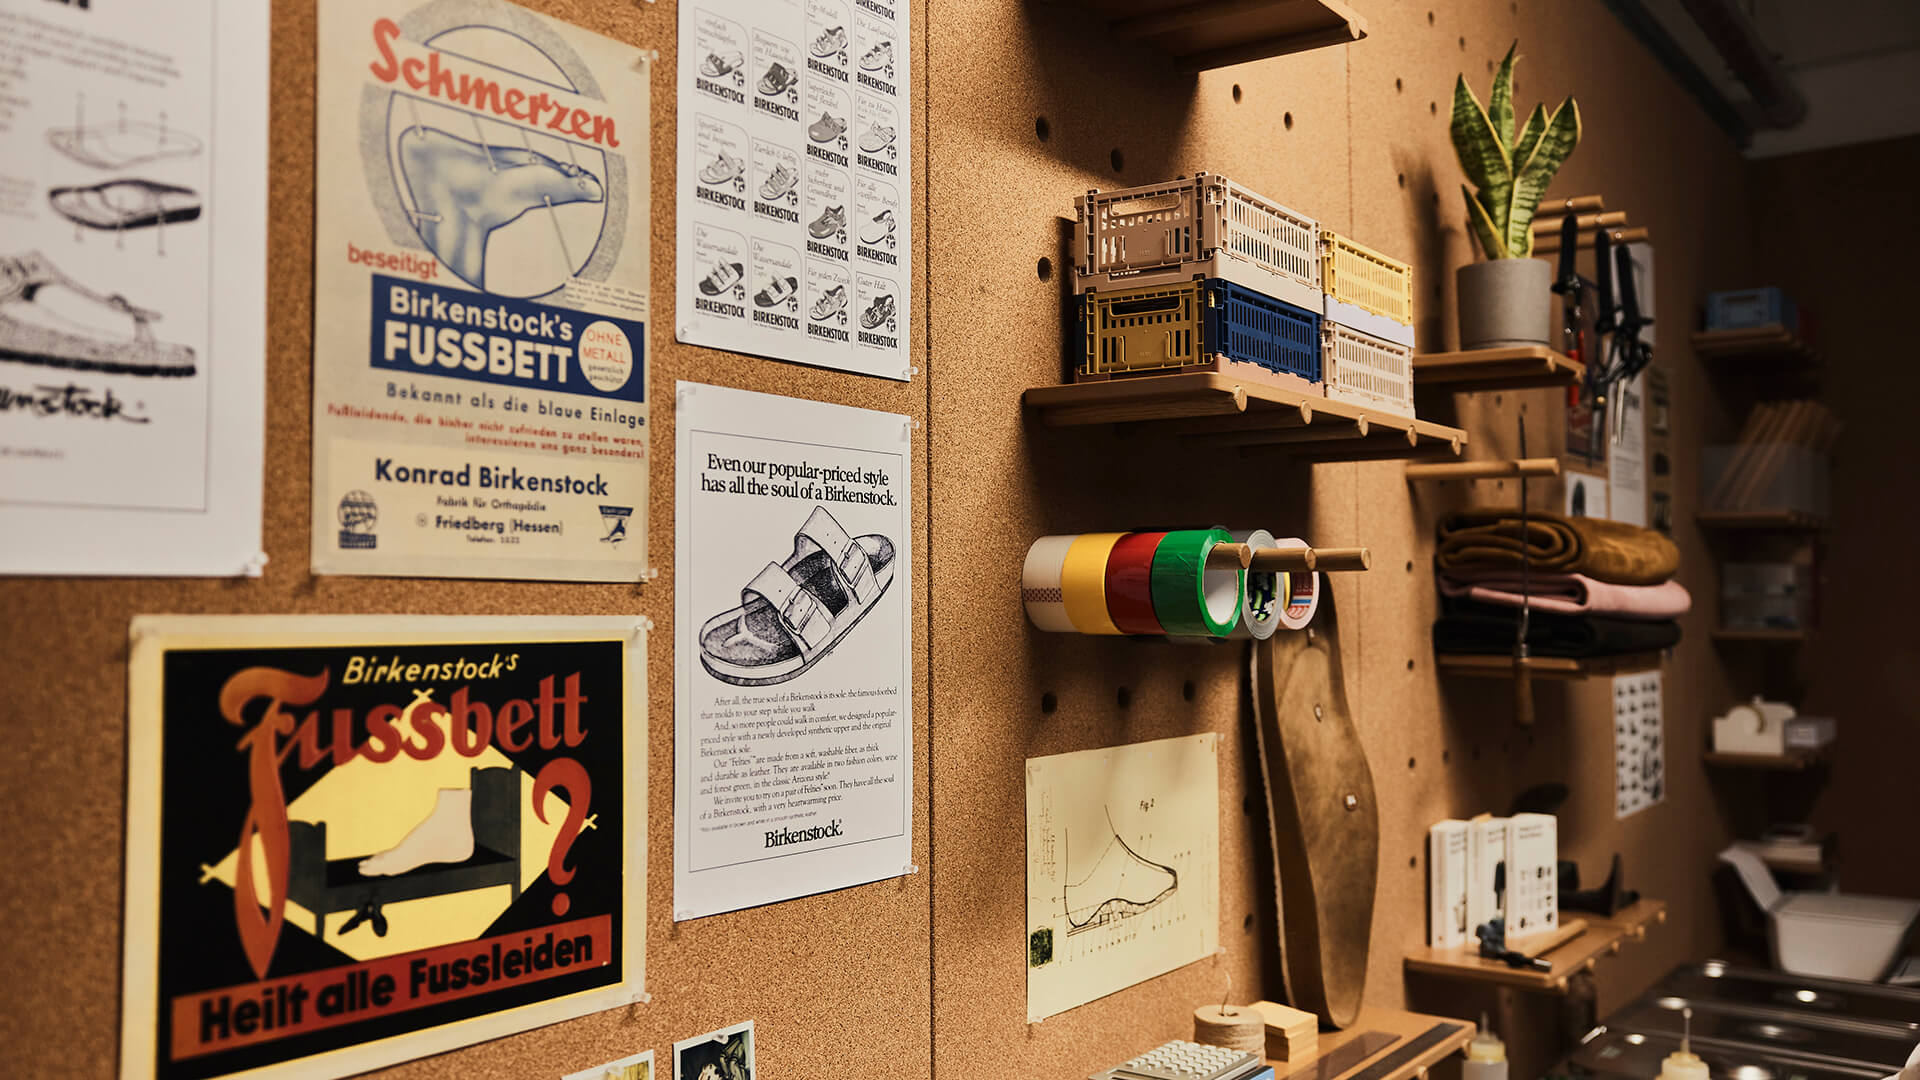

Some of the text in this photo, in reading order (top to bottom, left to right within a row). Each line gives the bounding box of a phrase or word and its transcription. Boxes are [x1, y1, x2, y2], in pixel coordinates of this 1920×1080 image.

[370, 18, 620, 148] Schmerzen
[807, 57, 849, 83] BIRKENSTOCK
[696, 77, 744, 104] BIRKENSTOCK
[857, 71, 896, 97] BIRKENSTOCK
[754, 96, 799, 122] BIRKENSTOCK
[806, 143, 849, 168] BIRKENSTOCK
[857, 153, 897, 177] BIRKENSTOCK
[696, 185, 745, 211] BIRKENSTOCK
[754, 200, 799, 224] BIRKENSTOCK
[348, 242, 438, 279] beseitigt
[807, 239, 849, 262] BIRKENSTOCK
[856, 245, 897, 266] BIRKENSTOCK
[390, 286, 573, 341] Birkenstock's
[695, 297, 745, 319] BIRKENSTOCK
[753, 309, 799, 330] BIRKENSTOCK
[586, 329, 623, 346] OHNE
[807, 322, 849, 343] BIRKENSTOCK
[857, 330, 897, 349] BIRKENSTOCK
[384, 321, 572, 383] FUSSBETT
[583, 346, 626, 364] METALL
[386, 381, 645, 429] Bekannt als die blaue Einlage
[413, 413, 432, 425] die
[478, 420, 504, 432] nicht
[510, 422, 557, 438] zufrieden
[562, 431, 573, 440] zu
[578, 432, 609, 444] stellen
[613, 436, 644, 447] waren,
[465, 432, 536, 448] interessieren
[541, 441, 558, 451] uns
[562, 444, 587, 455] ganz
[375, 457, 609, 496] Konrad Birkenstock
[707, 453, 889, 488] Even our popular-priced style
[701, 472, 897, 506] has all the soul of a Birkenstock.
[436, 515, 563, 536] Friedberg (Hessen)
[341, 653, 519, 686] Birkenstock's
[531, 757, 593, 917] ?
[199, 928, 593, 1043] Heilt alle Fussleiden
